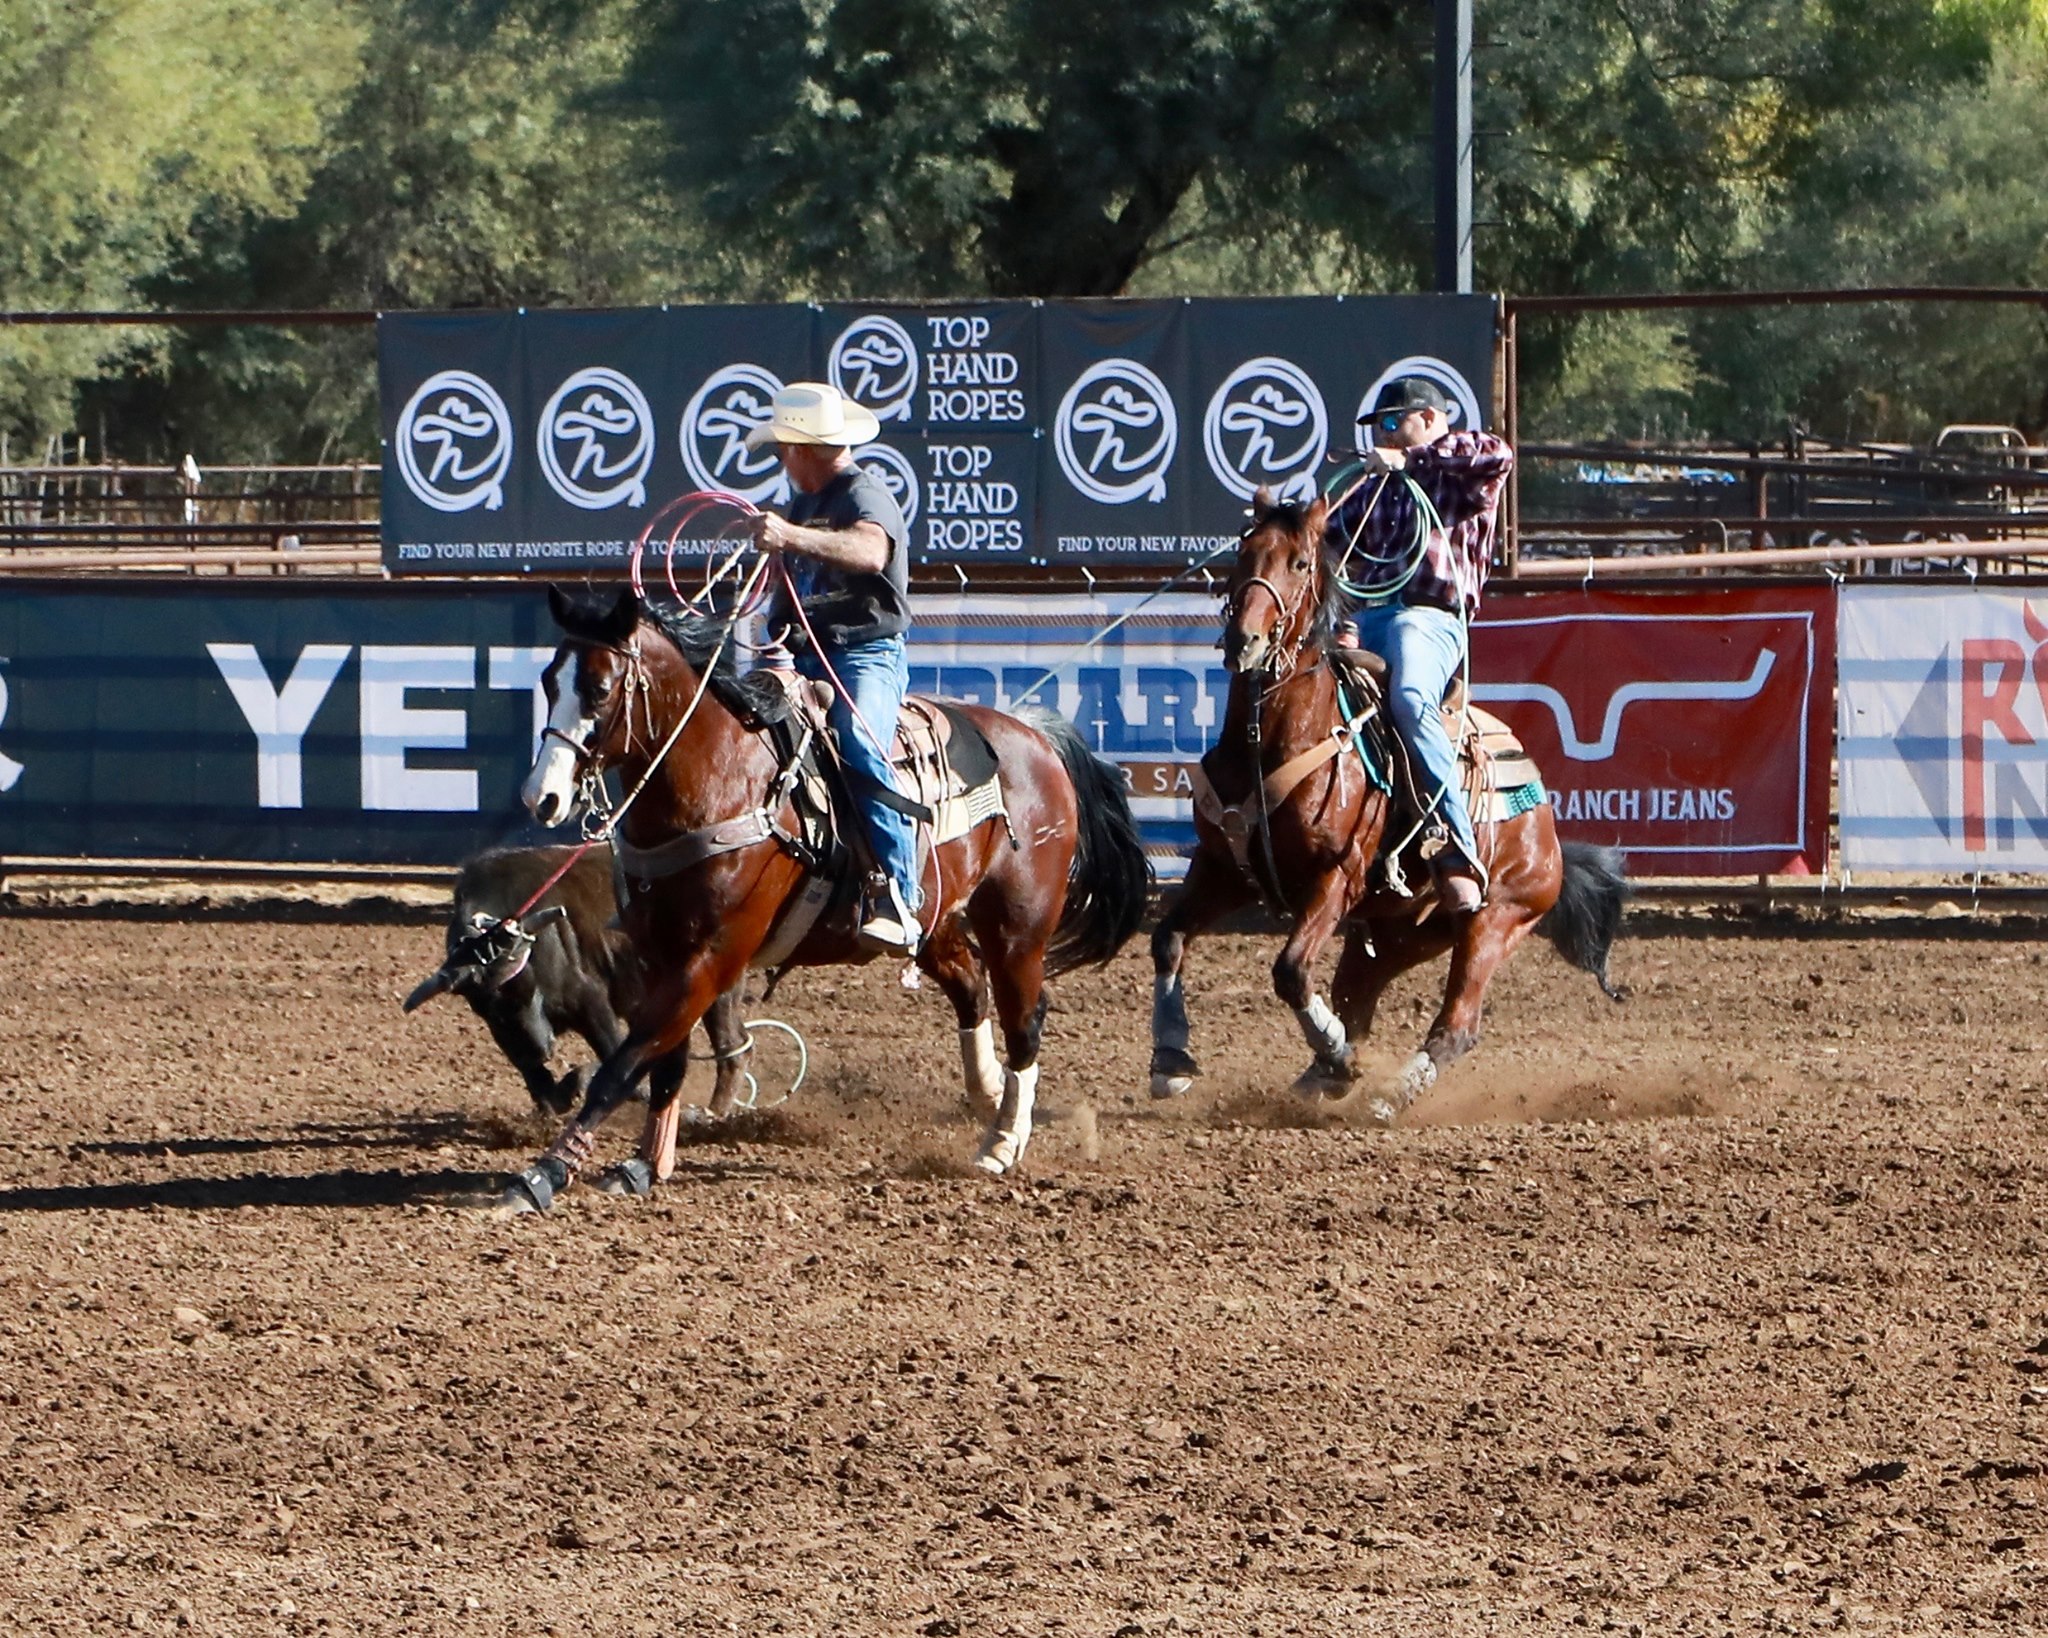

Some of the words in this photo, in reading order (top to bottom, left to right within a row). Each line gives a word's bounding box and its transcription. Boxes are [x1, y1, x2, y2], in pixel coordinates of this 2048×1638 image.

[926, 316, 990, 348] TOP
[926, 353, 1019, 385] HAND
[927, 389, 1026, 422] ROPES
[927, 445, 993, 477] TOP
[926, 482, 1019, 514] HAND
[398, 544, 432, 559] FIND
[434, 543, 475, 559] YOUR
[477, 543, 513, 558] NEW
[515, 541, 584, 558] FAVORITE
[586, 541, 624, 556] ROPE
[926, 519, 1023, 551] ROPES
[1057, 537, 1092, 552] FIND
[1095, 537, 1137, 552] YOUR
[1140, 536, 1176, 551] NEW
[1547, 789, 1641, 821] RANCH
[1647, 788, 1737, 821] JEANS
